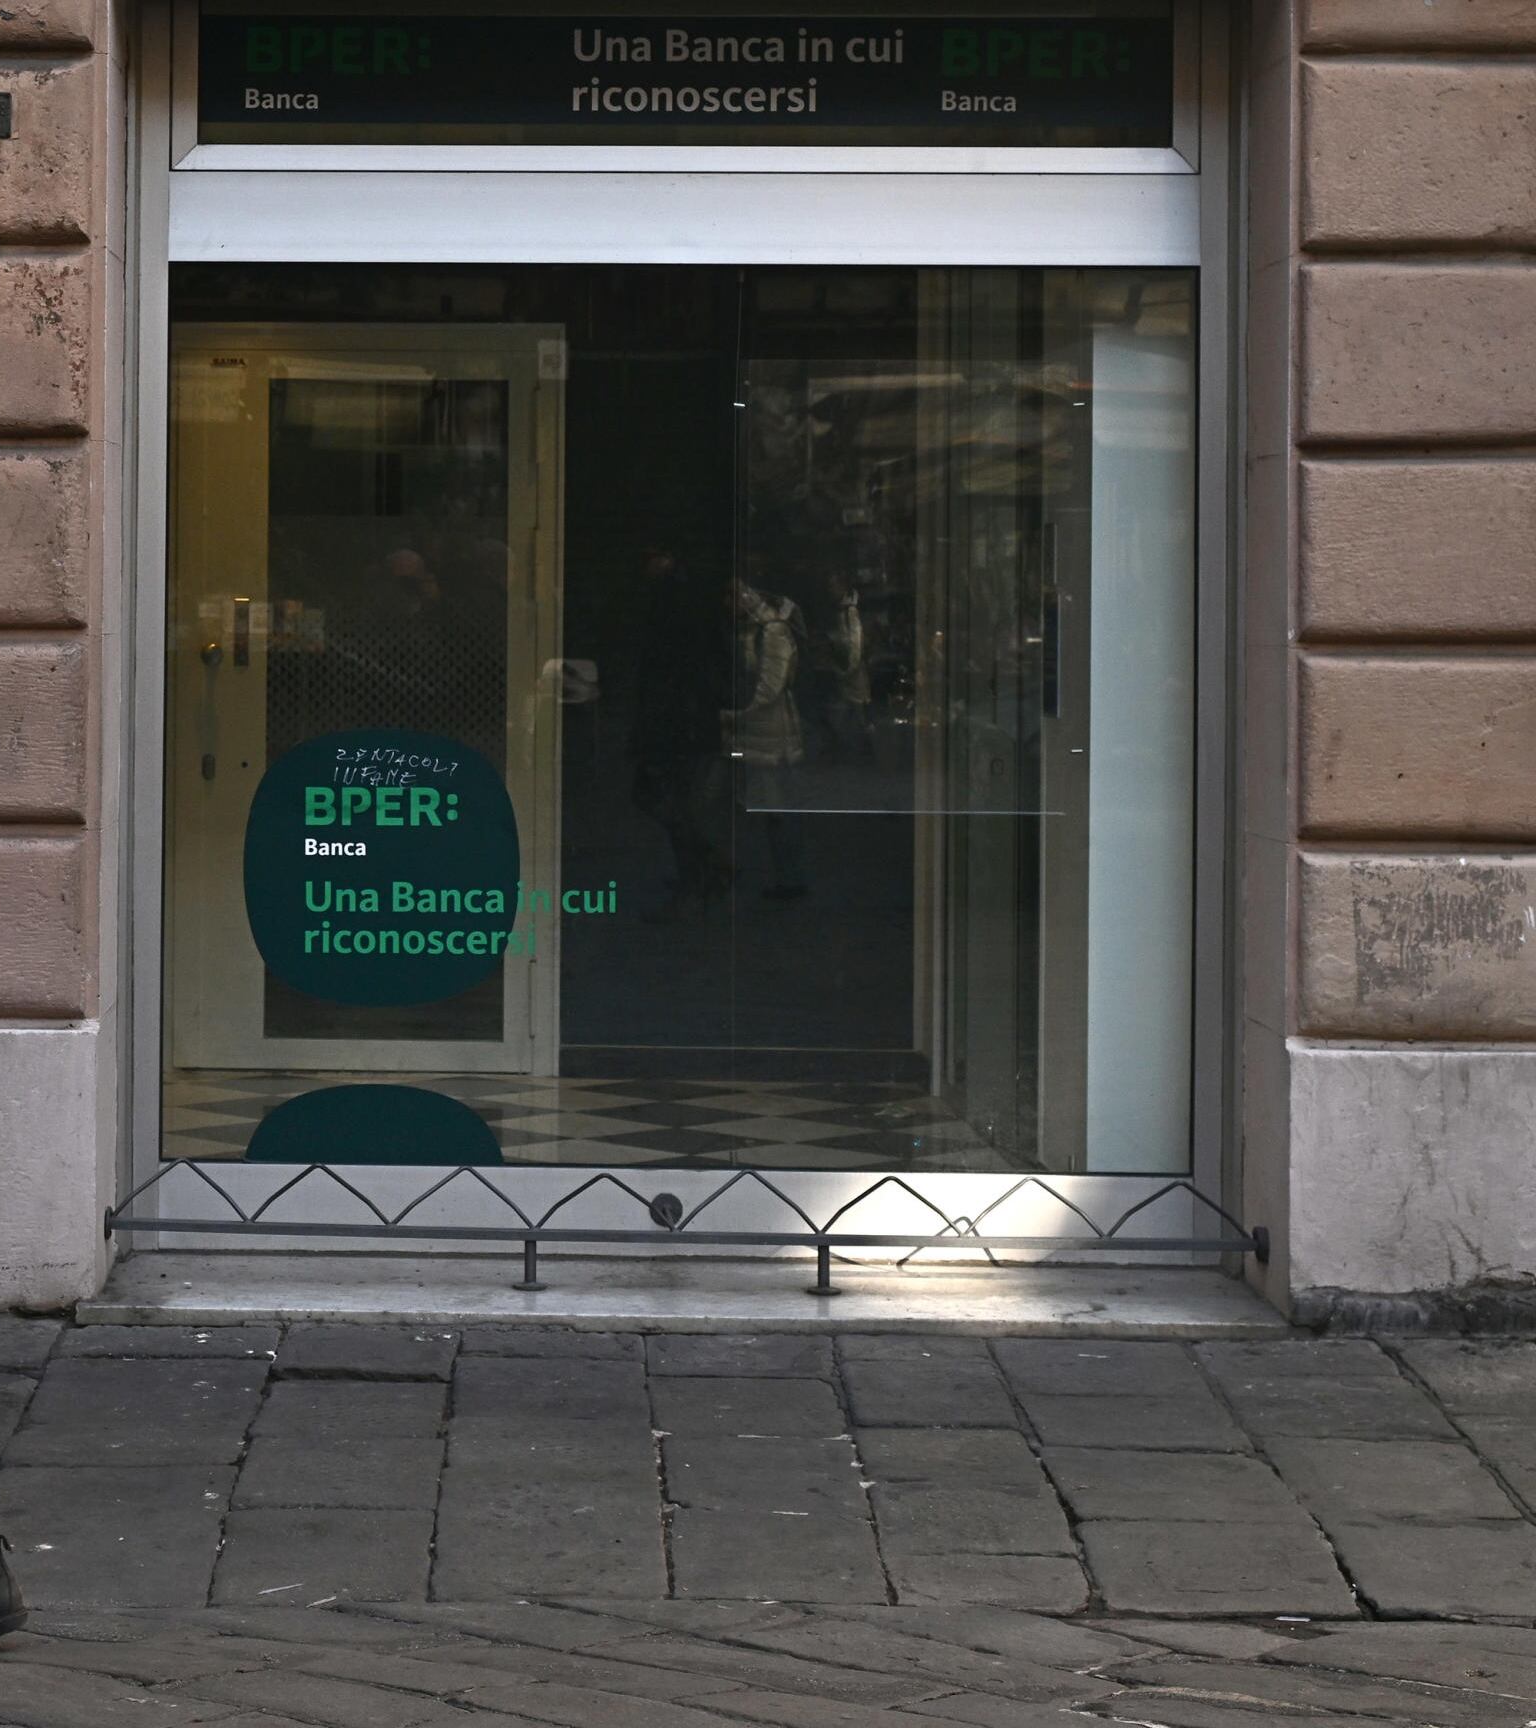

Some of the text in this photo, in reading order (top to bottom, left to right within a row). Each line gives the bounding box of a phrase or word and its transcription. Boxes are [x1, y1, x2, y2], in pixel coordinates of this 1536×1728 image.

[573, 27, 904, 64] Una Banca in cui
[244, 88, 319, 110] Banca
[572, 77, 817, 113] riconoscersi
[941, 90, 1017, 113] Banca
[304, 786, 459, 827] BPER:
[304, 838, 367, 857] Banca
[305, 880, 617, 914] Una Banca in cui
[304, 920, 536, 955] riconoscersi
